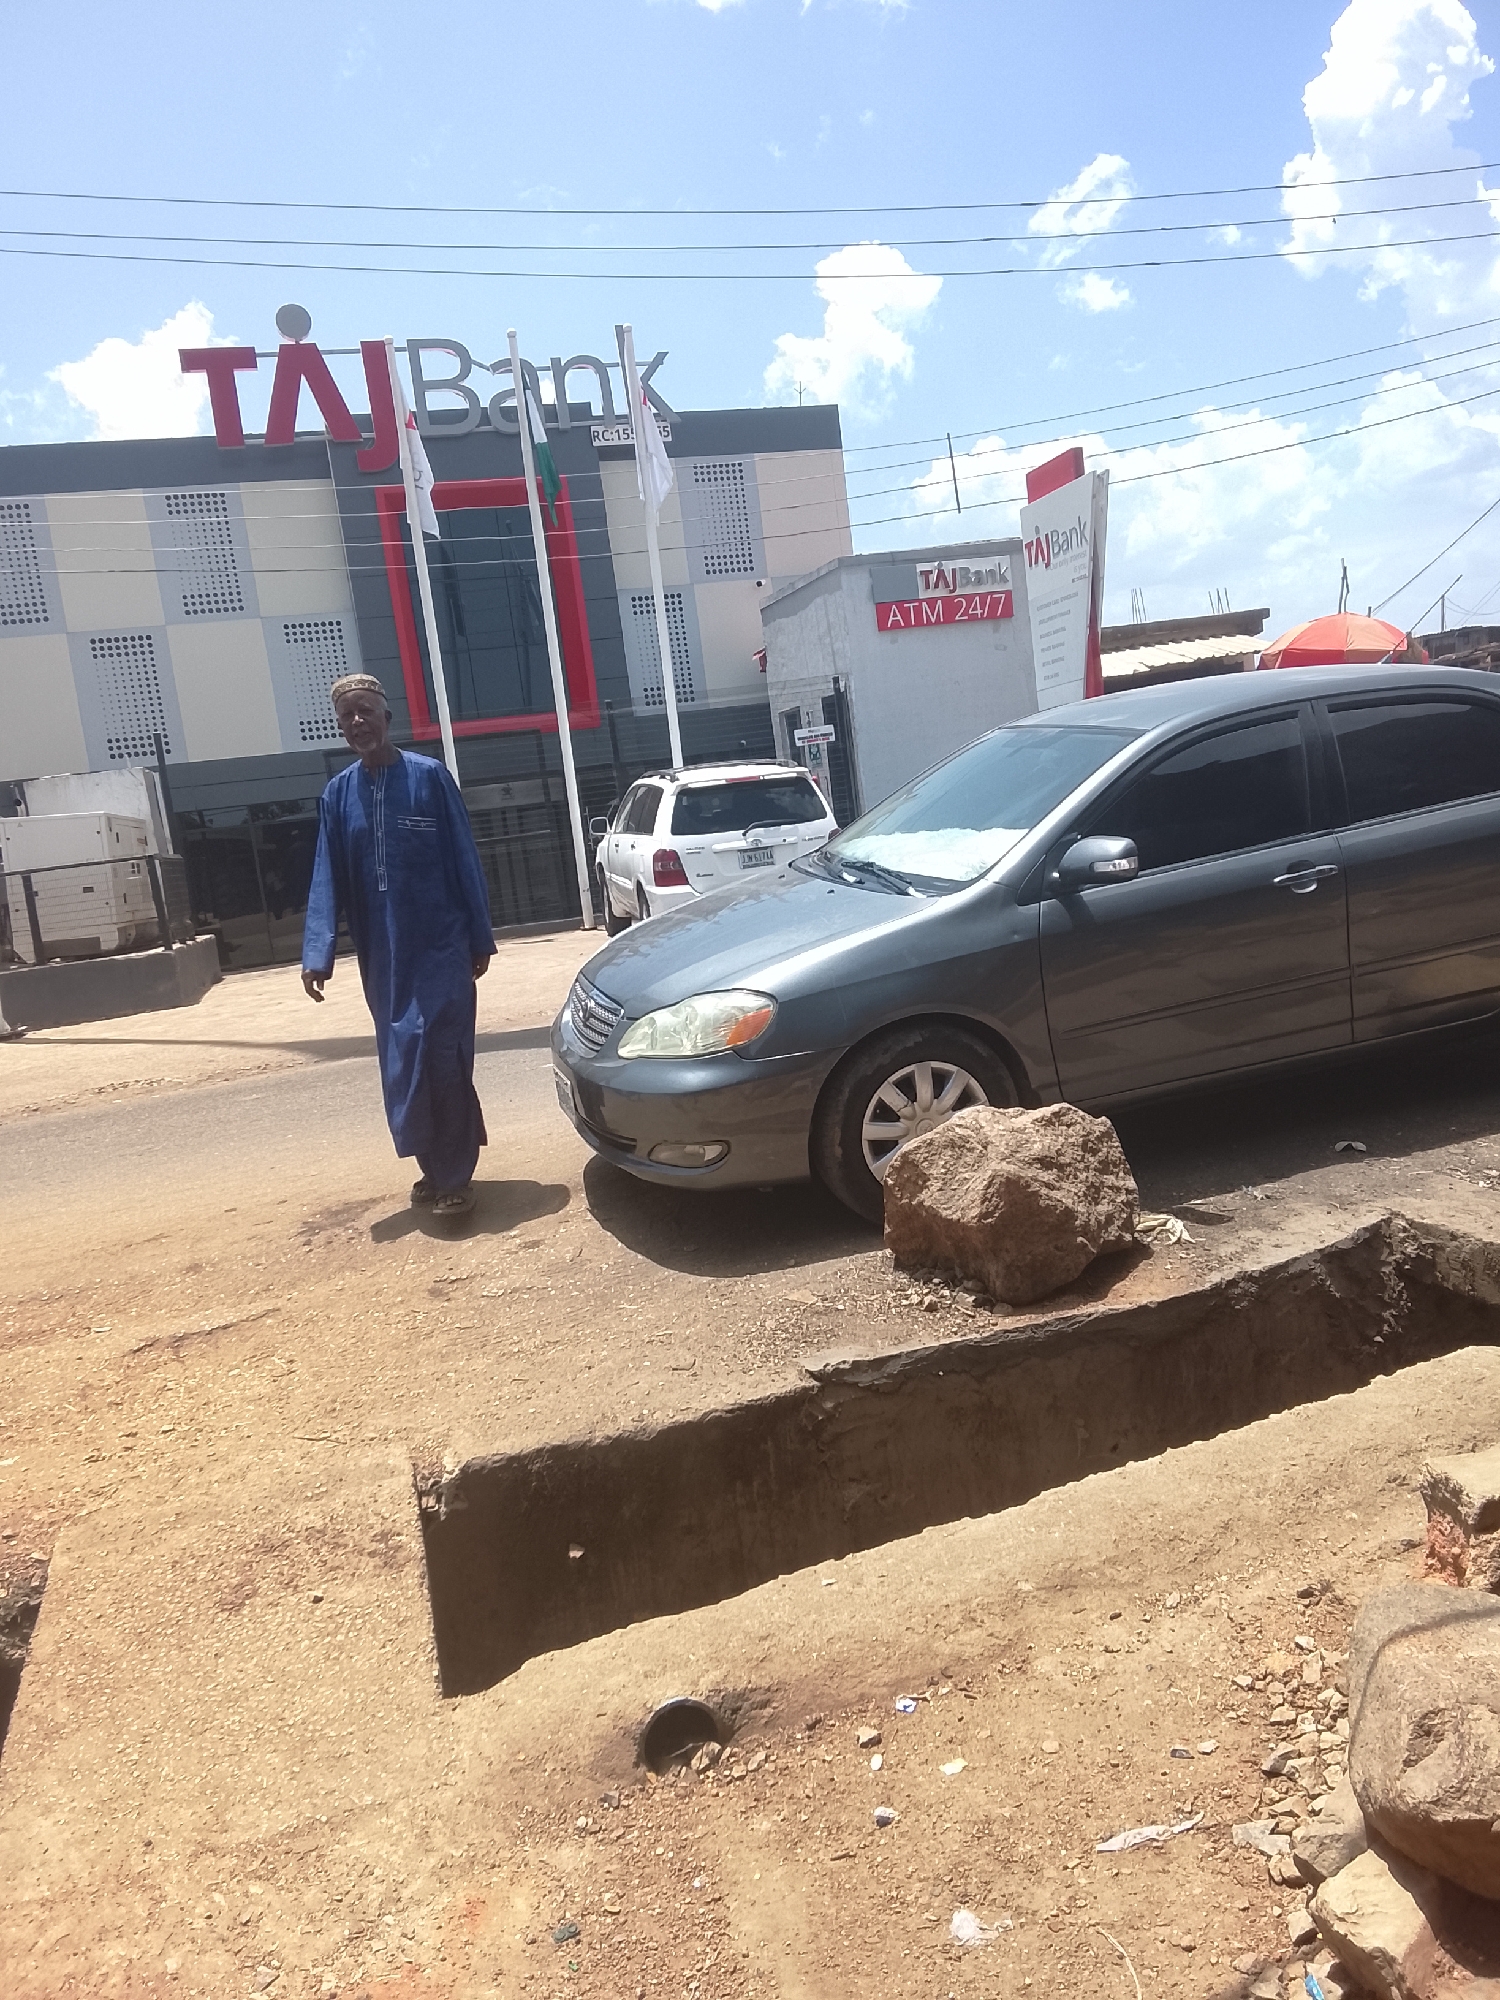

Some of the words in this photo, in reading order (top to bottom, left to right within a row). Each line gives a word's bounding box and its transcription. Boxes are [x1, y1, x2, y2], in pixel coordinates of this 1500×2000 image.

[178, 303, 682, 473] TAJBank
[1024, 515, 1089, 571] TAJBank
[919, 560, 1010, 594] TAJBank
[887, 599, 944, 628] ATM
[953, 593, 1006, 621] 24/7
